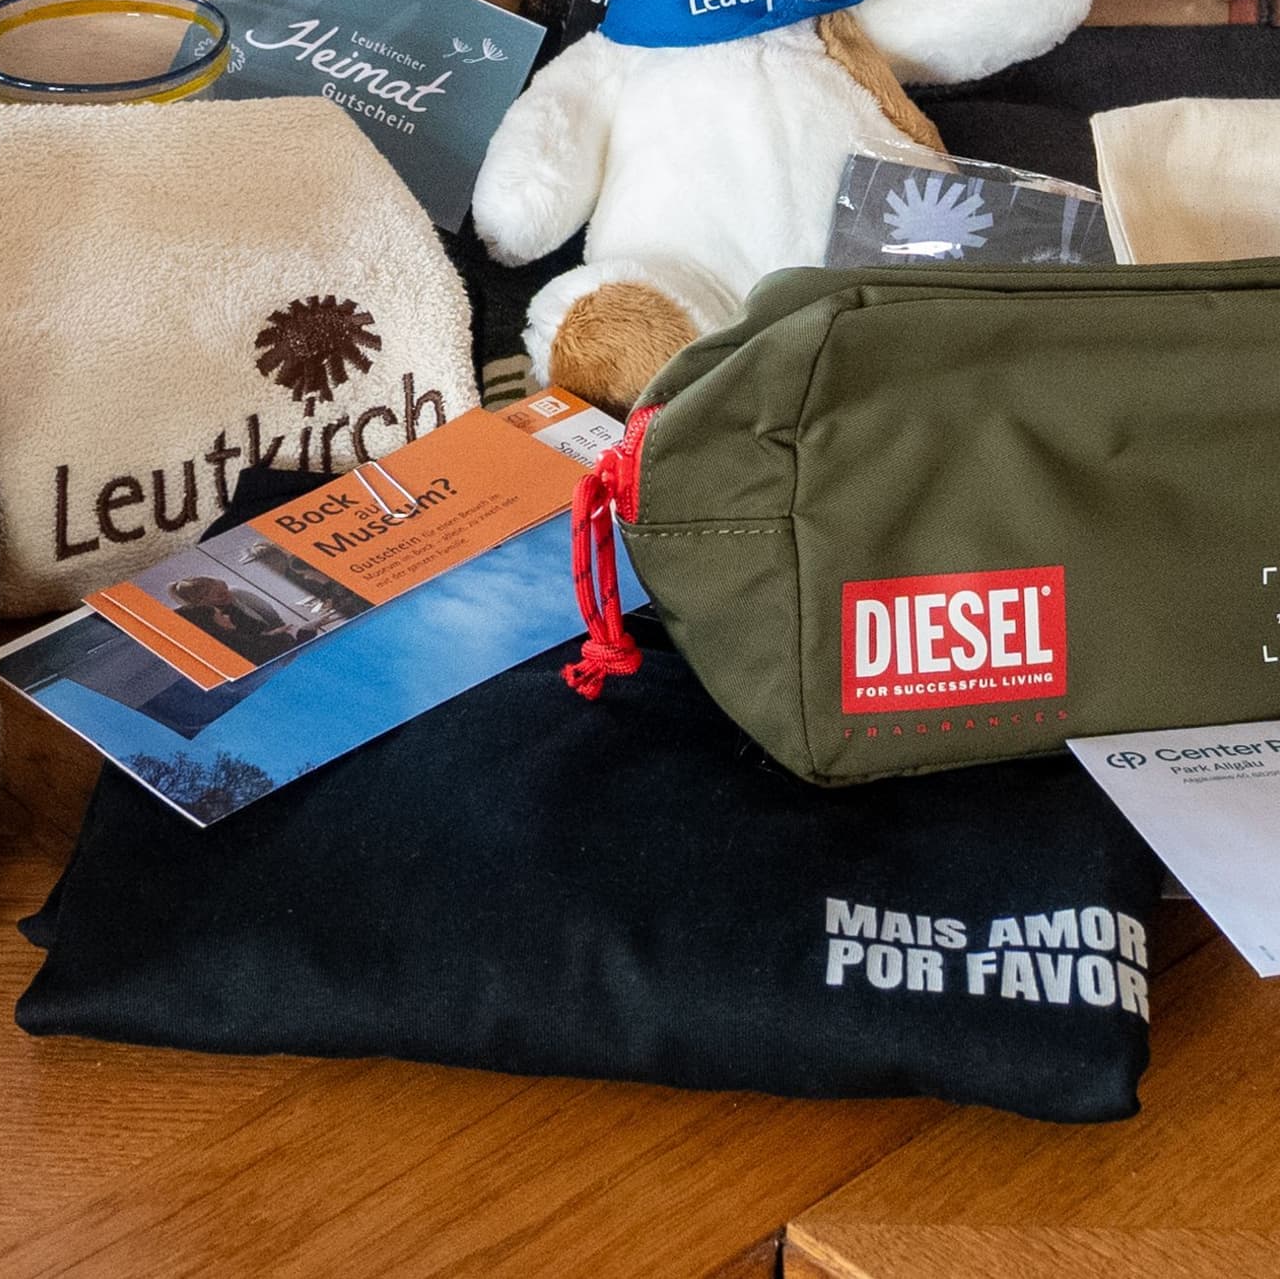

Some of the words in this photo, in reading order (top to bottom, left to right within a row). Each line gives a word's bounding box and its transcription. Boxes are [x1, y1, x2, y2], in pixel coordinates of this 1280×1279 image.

[245, 19, 453, 113] Heimat
[350, 30, 427, 71] Leutkircher
[322, 82, 416, 136] Gutschein
[572, 434, 598, 451] mit
[589, 424, 612, 441] Ein
[54, 371, 446, 561] Leutkirch
[274, 489, 359, 535] Bock
[312, 476, 459, 559] Museum?
[354, 499, 383, 522] au
[349, 535, 422, 574] Gutschein
[855, 585, 1054, 678] DIESEL
[856, 686, 889, 699] FOR
[893, 677, 998, 696] SUCCESSFUL
[1002, 672, 1054, 687] LIVING
[843, 709, 1069, 740] FRAGRANCES
[1169, 763, 1211, 775] Park
[1213, 759, 1265, 771] Allgäu
[825, 896, 968, 950] MAIS
[988, 906, 1149, 970] AMOR
[825, 937, 945, 994] POR
[965, 950, 1151, 1025] FAVOR
